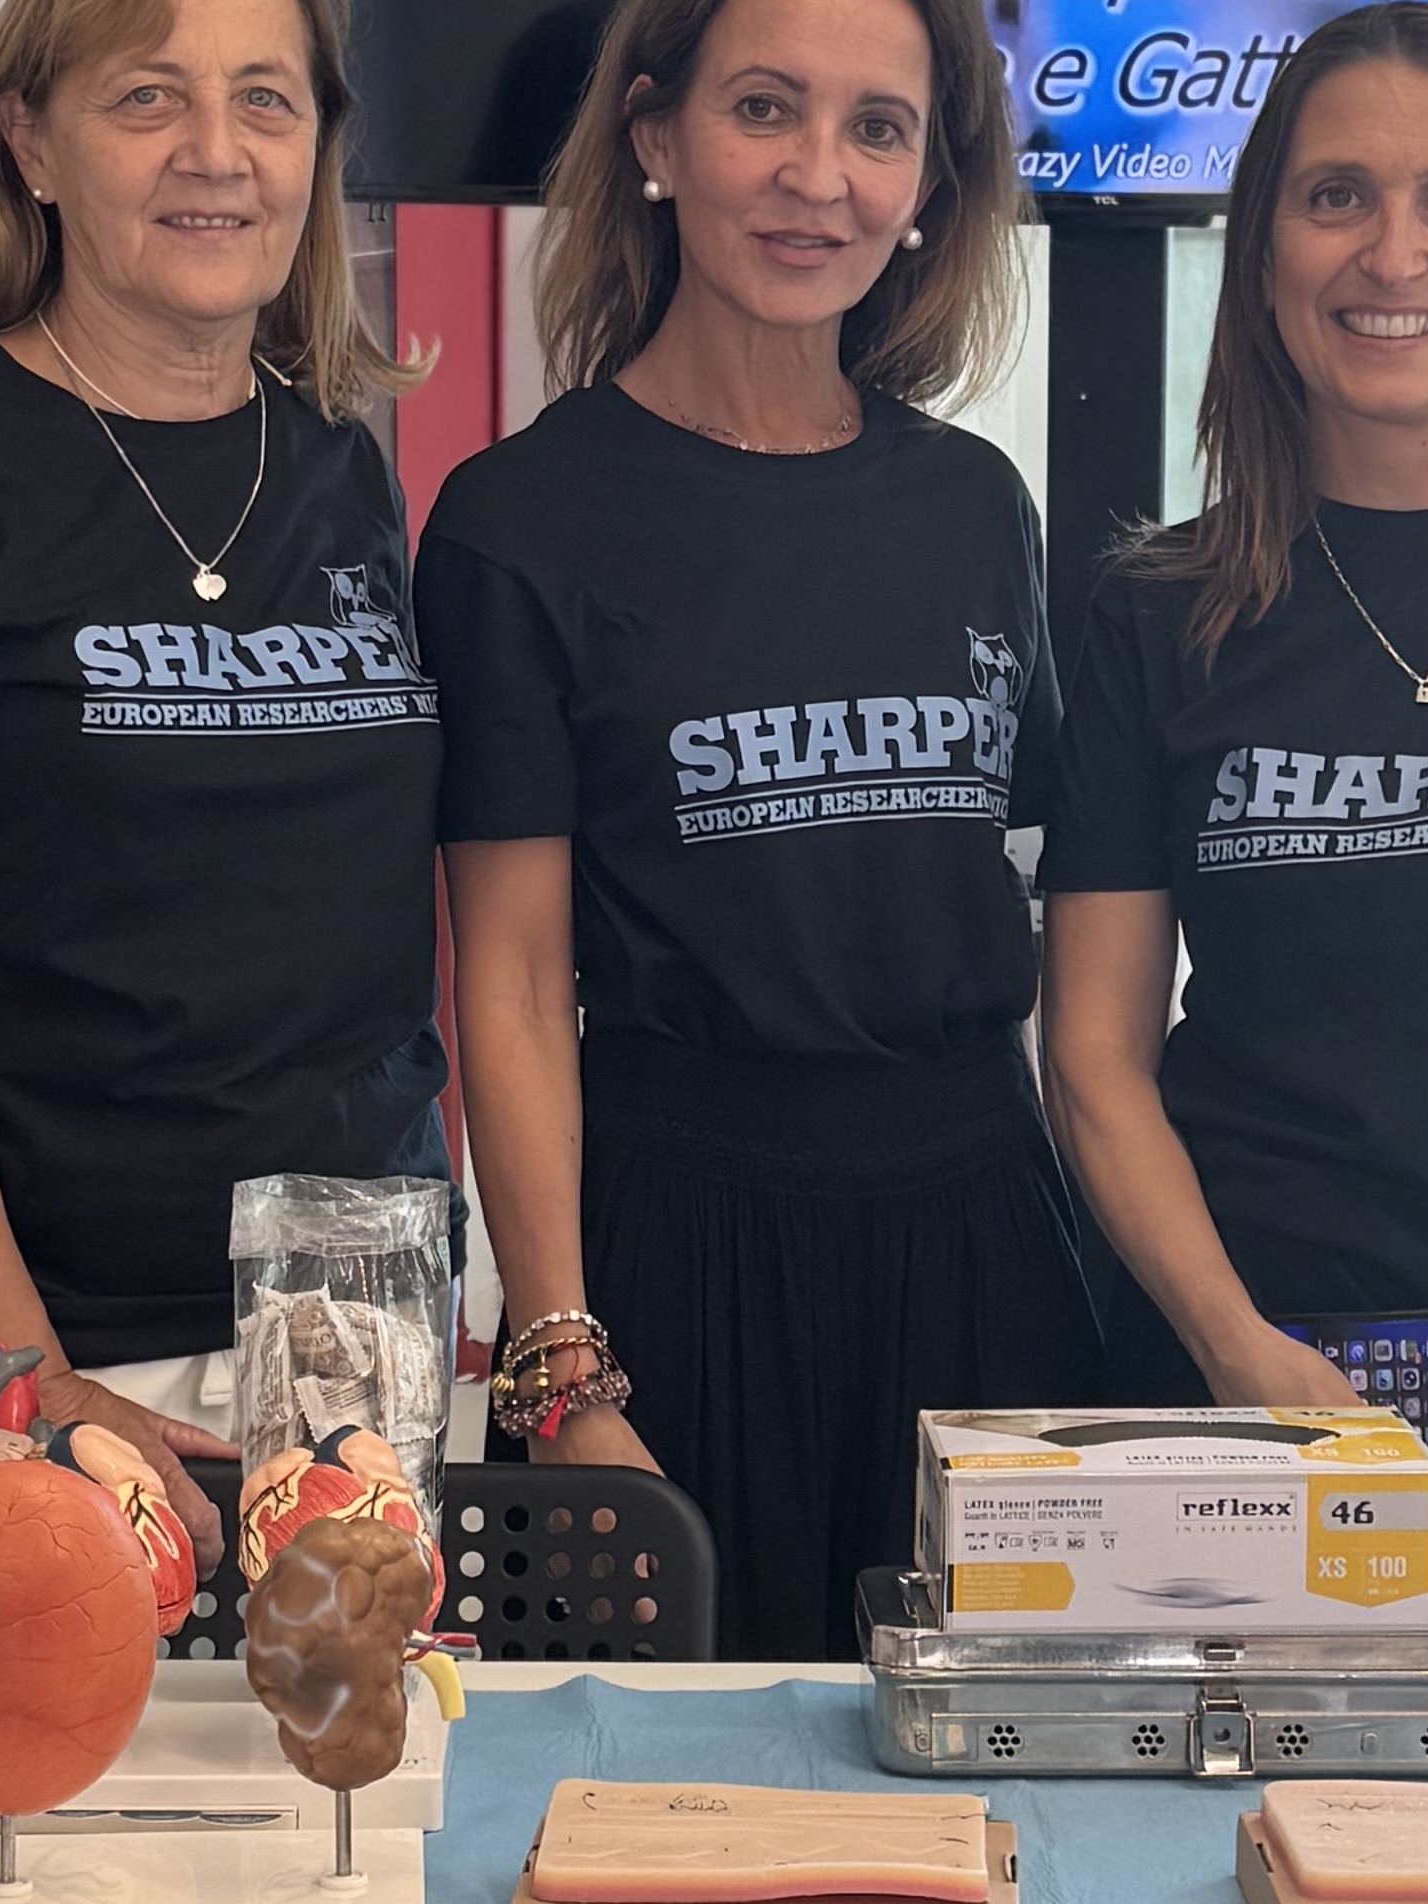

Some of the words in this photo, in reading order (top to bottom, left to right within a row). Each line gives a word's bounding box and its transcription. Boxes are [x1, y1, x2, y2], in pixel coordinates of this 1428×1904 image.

[1032, 46, 1092, 111] e
[1092, 143, 1192, 180] Video
[1093, 195, 1119, 206] TCL
[81, 701, 232, 727] EUROPEAN
[239, 696, 408, 727] RESEARCHERS'
[669, 696, 1019, 796] SHARPER
[676, 795, 815, 836] EUROPEAN
[820, 786, 990, 816] RESEARCHER
[1197, 833, 1328, 865] EUROPEAN
[1362, 1446, 1400, 1458] 100
[964, 1499, 994, 1509] LATEX
[1037, 1498, 1077, 1508] POWDER
[1080, 1498, 1103, 1508] FREE
[999, 1510, 1031, 1520] LATTICE
[1037, 1510, 1064, 1520] SENZA
[1066, 1509, 1103, 1520] POLVERE
[1183, 1498, 1292, 1517] reflexx
[1330, 1500, 1374, 1525] 46
[1317, 1556, 1348, 1579] XS
[1367, 1555, 1407, 1579] 100
